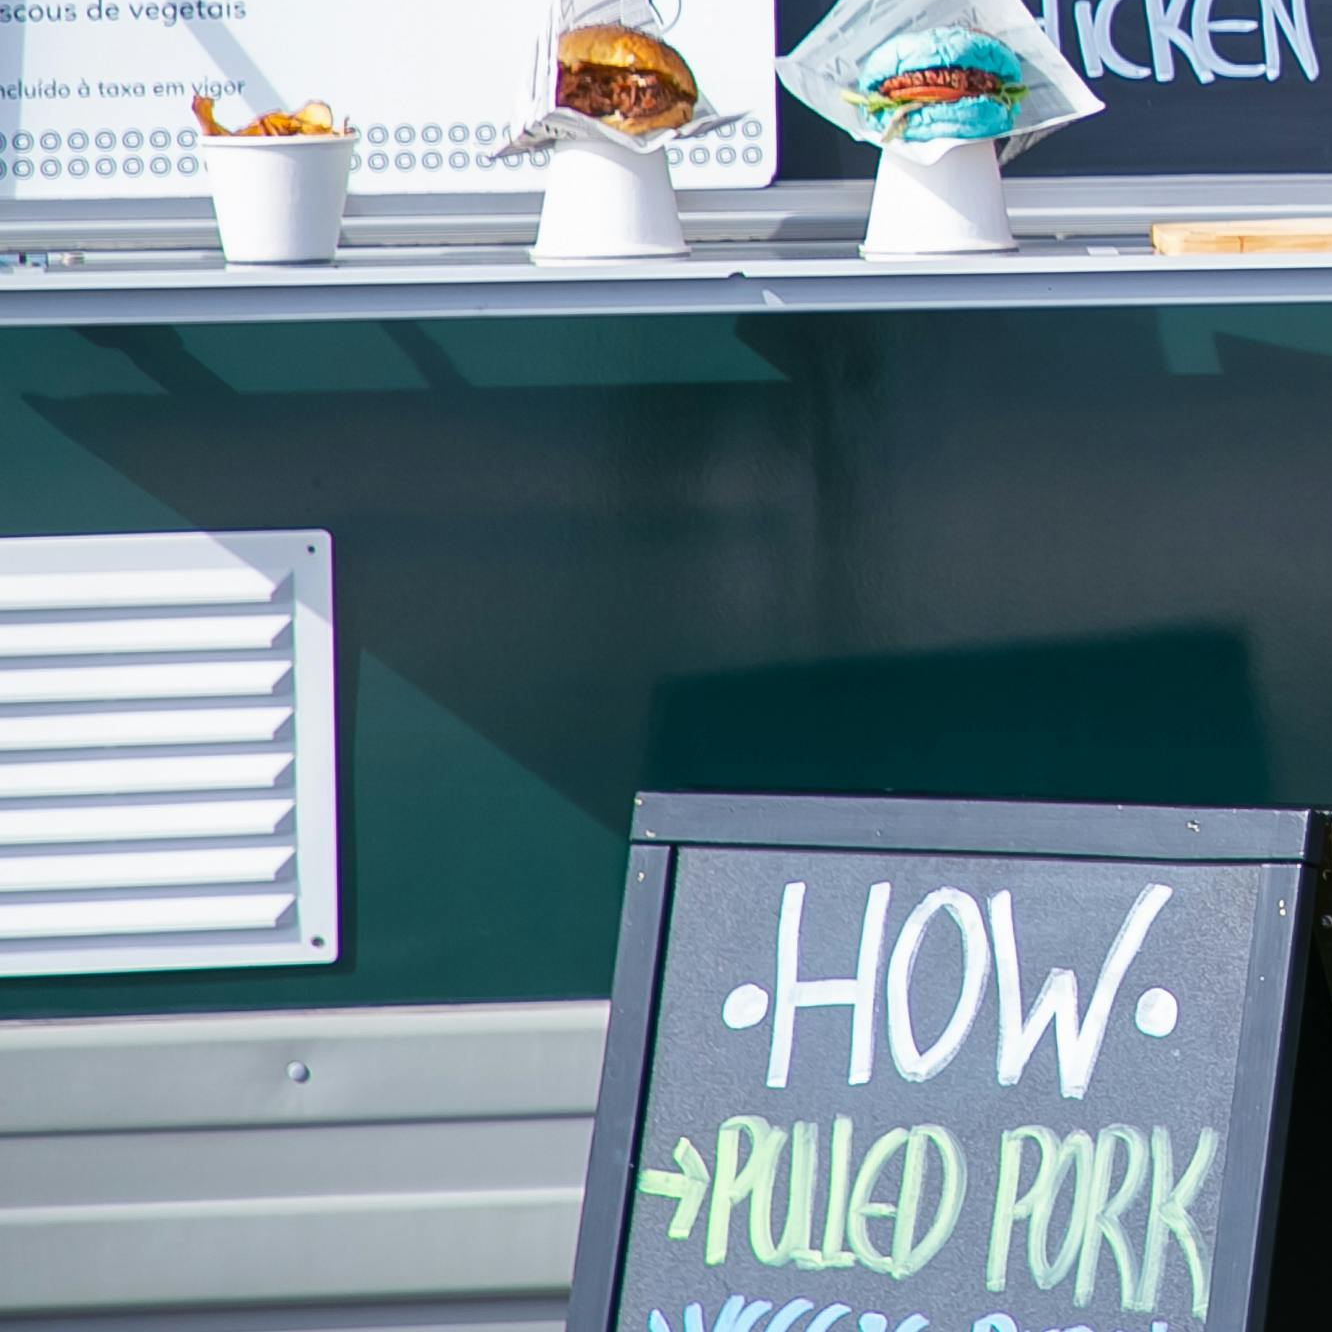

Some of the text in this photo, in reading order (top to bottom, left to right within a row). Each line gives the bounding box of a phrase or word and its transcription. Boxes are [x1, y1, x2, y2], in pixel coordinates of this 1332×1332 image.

[98, 79, 146, 98] taxa
[152, 81, 185, 97] em
[191, 75, 247, 101] vigor
[765, 881, 1174, 1100] HOW
[704, 1114, 1220, 1320] PULLED PORK
